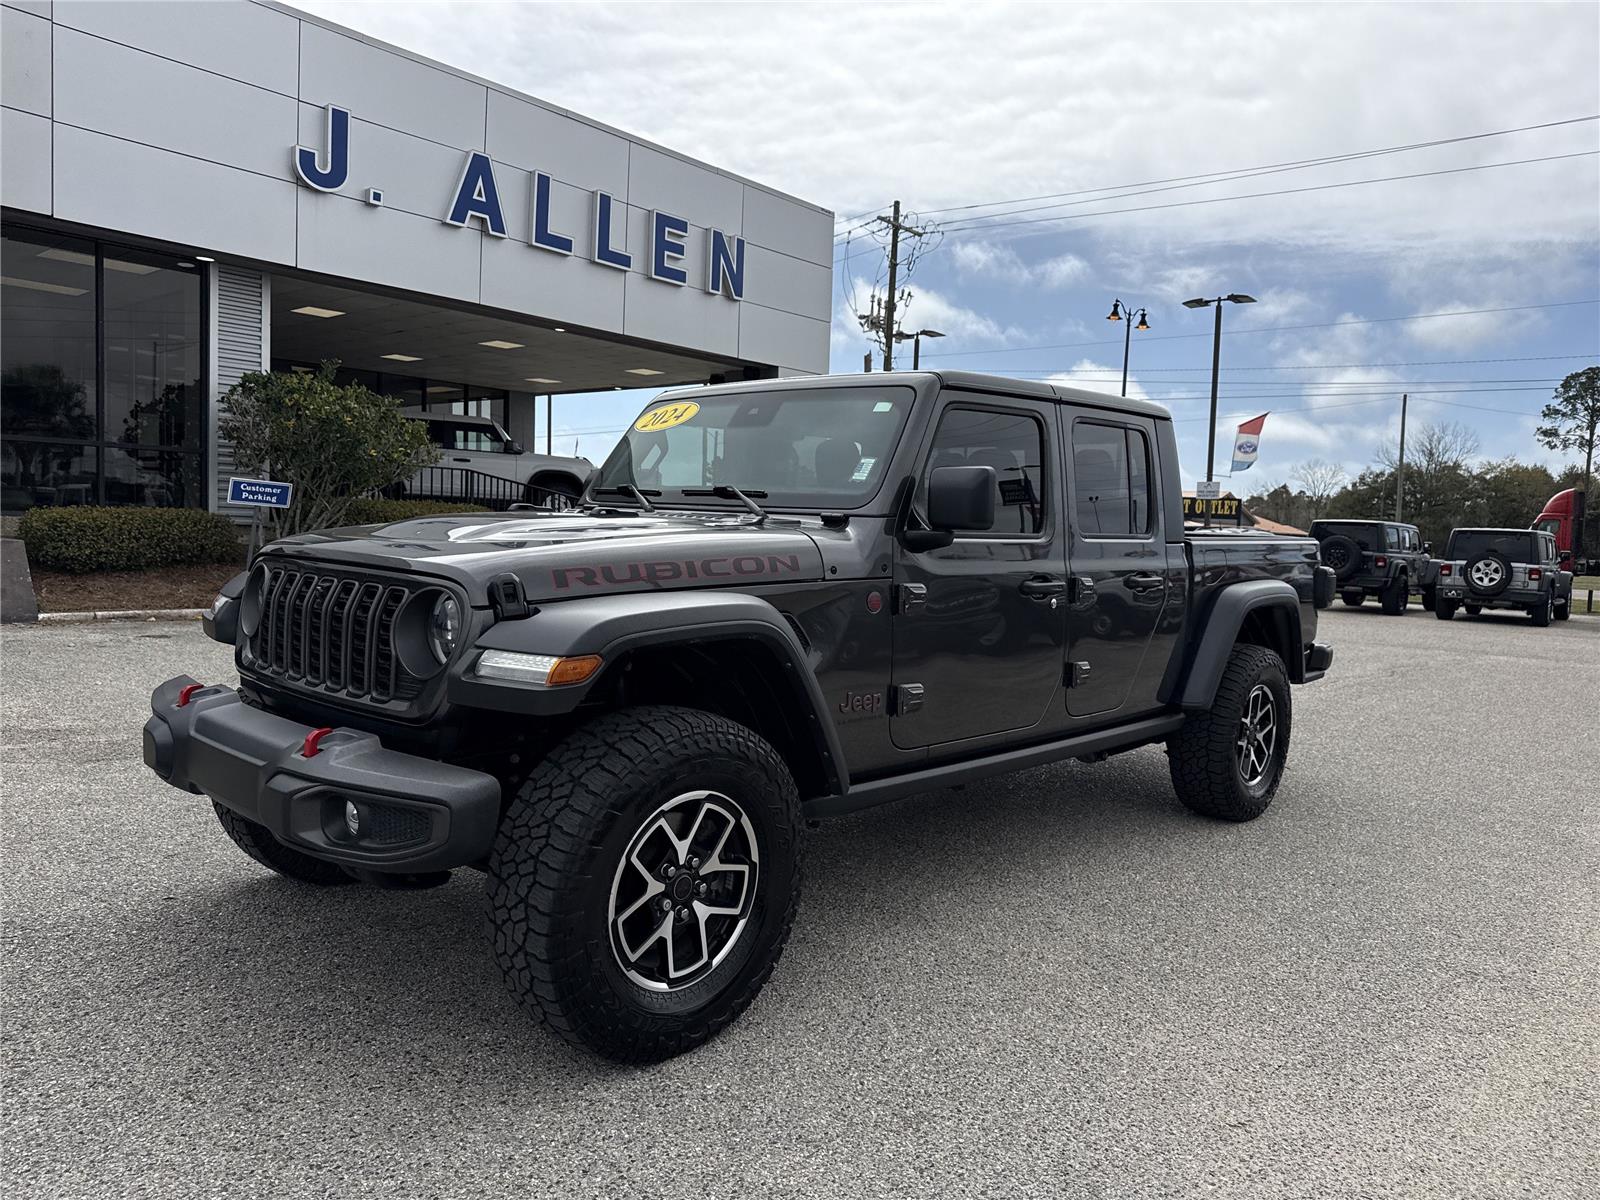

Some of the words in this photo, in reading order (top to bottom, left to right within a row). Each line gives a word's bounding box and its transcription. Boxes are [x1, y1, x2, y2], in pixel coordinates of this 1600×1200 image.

[291, 103, 384, 207] J.
[443, 149, 747, 300] ALLEN
[640, 404, 692, 429] 2024
[240, 483, 282, 494] Customer
[241, 491, 278, 503] Parking
[551, 554, 801, 590] RUBICON
[839, 690, 881, 714] Jeep
